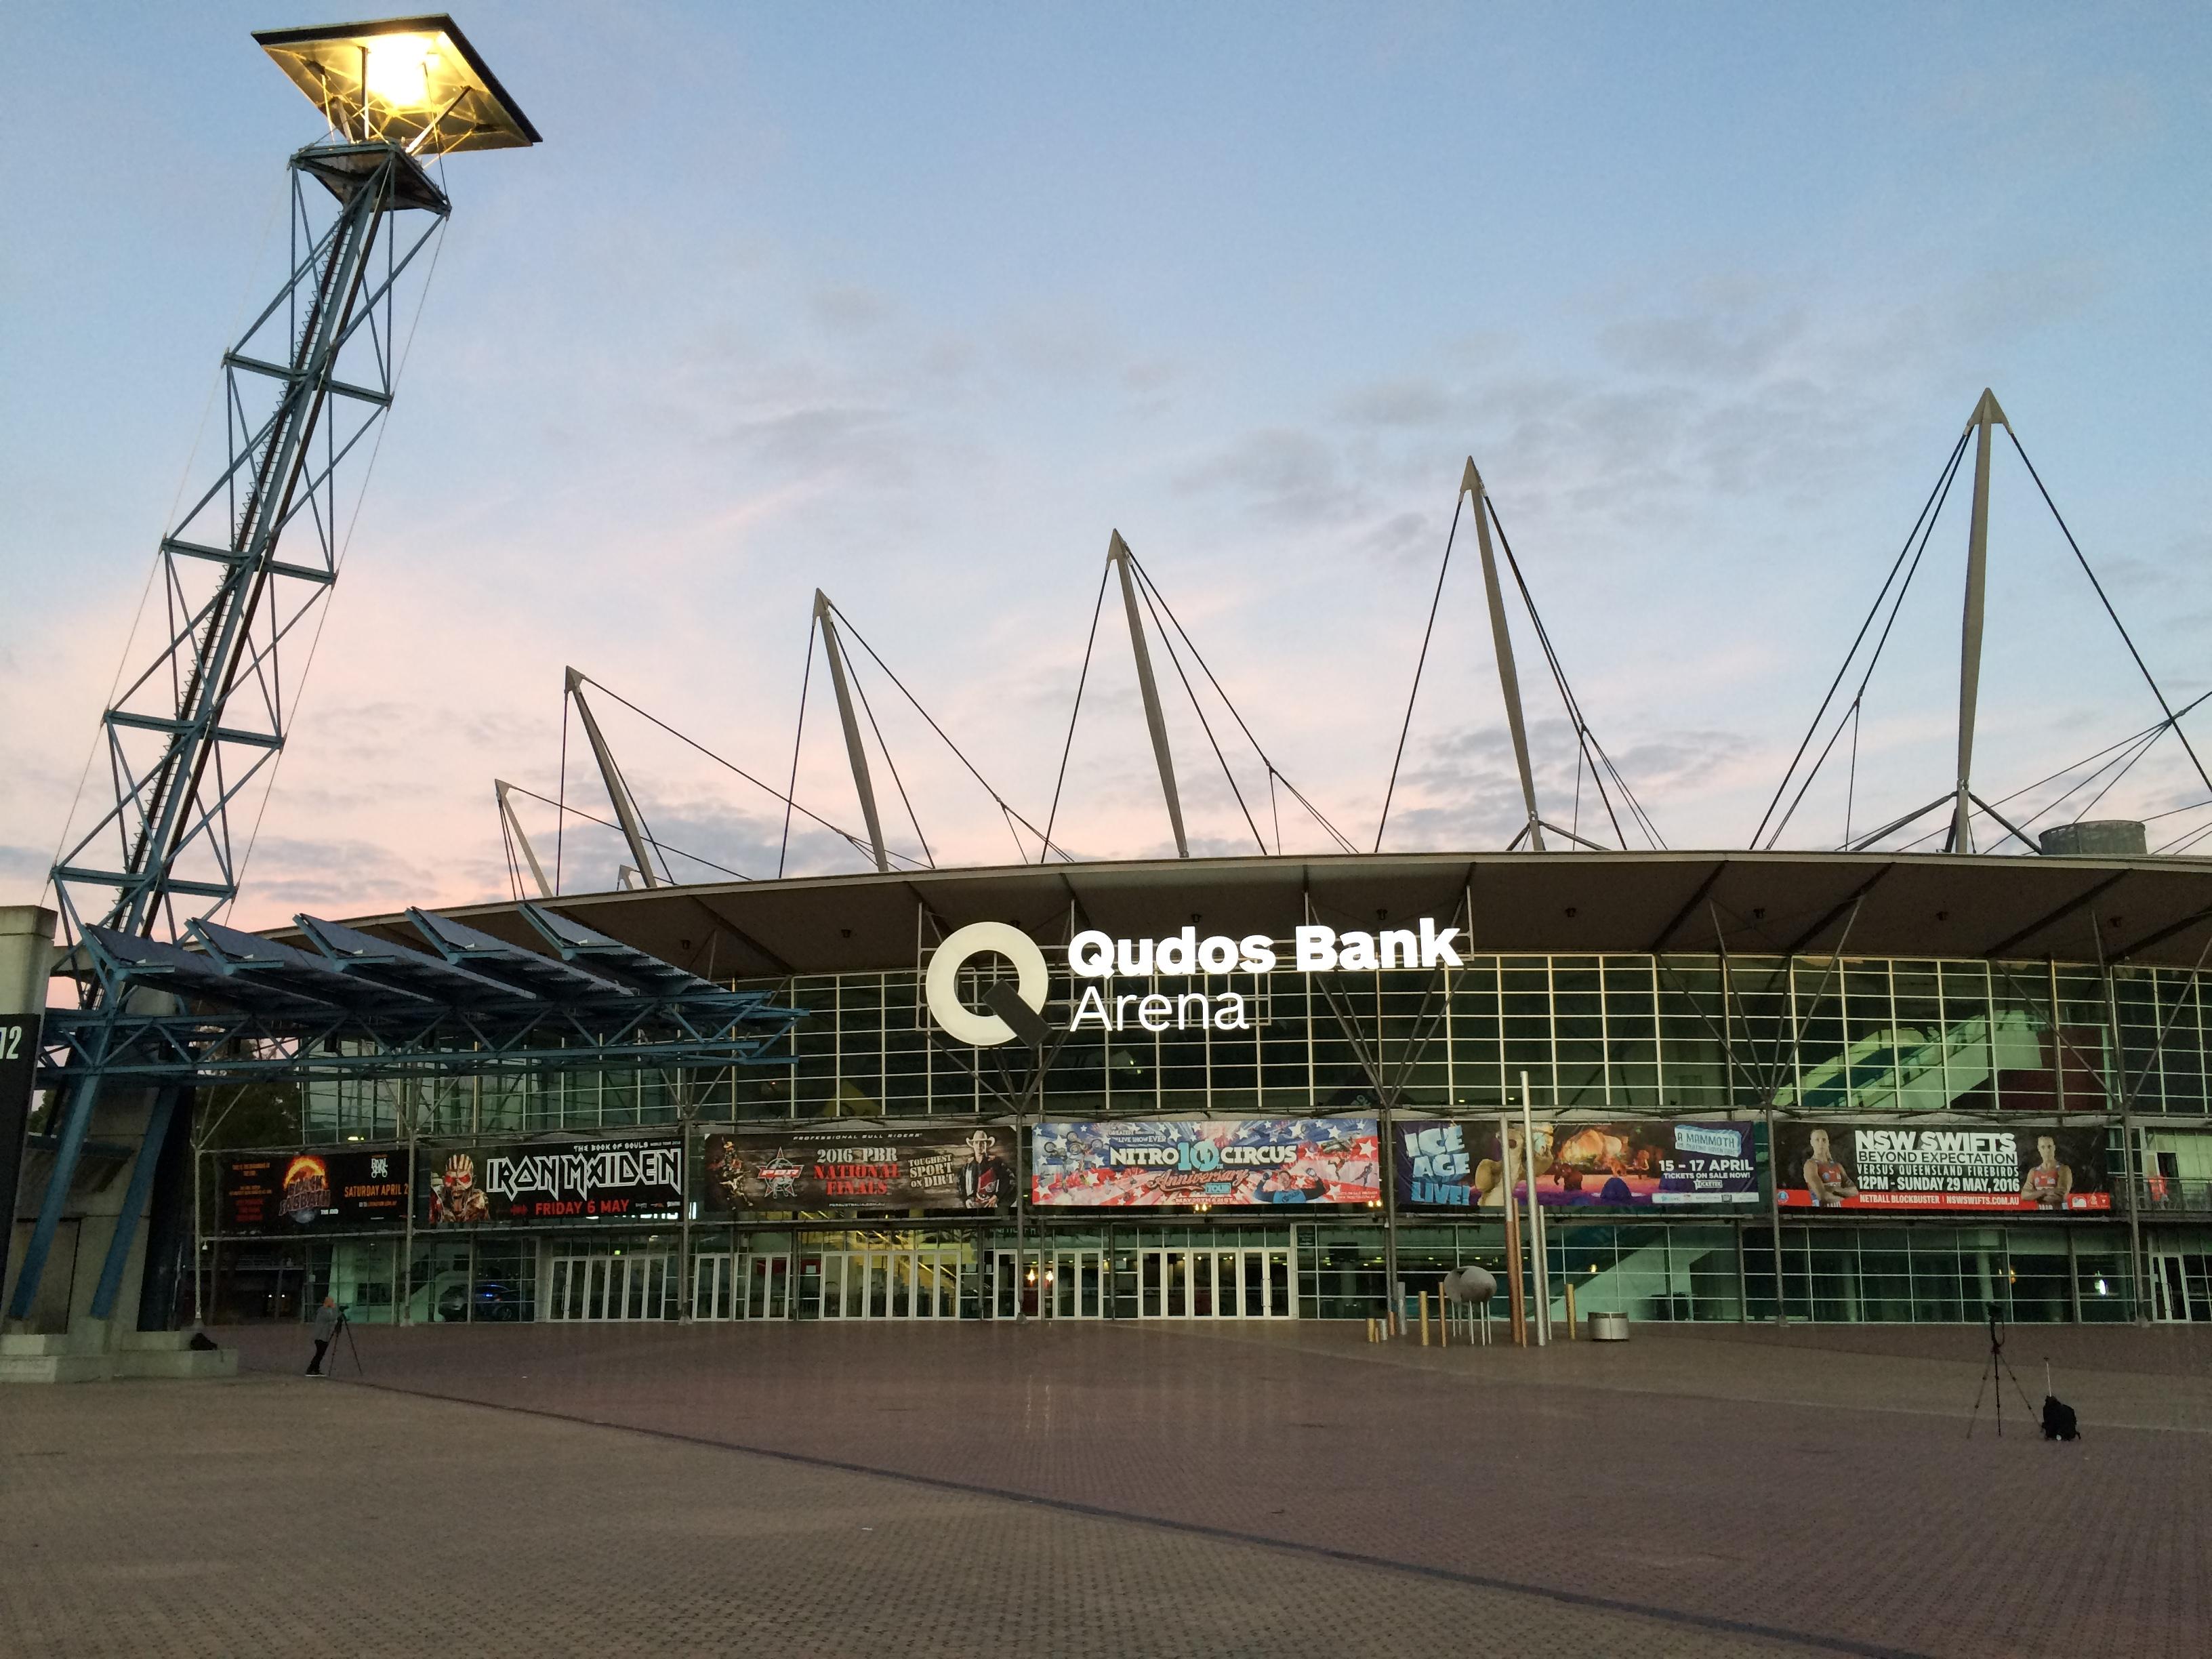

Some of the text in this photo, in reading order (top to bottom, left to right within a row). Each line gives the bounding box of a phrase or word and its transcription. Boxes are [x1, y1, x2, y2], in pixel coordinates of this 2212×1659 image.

[1067, 918, 1465, 978] Qudos Bank
[1069, 985, 1250, 1032] Arena
[573, 1145, 589, 1153] THE
[591, 1143, 611, 1151] BOOK
[624, 1141, 649, 1149] SOULS
[1404, 1124, 1465, 1158] ICE
[1677, 1132, 1735, 1148] A MAMMOTH
[1855, 1130, 2017, 1152] NSW SWIFTS
[817, 1147, 898, 1164] 2016 PBR
[908, 1154, 953, 1168] TOUGHEST
[1109, 1147, 1179, 1166] NITRO
[1221, 1145, 1298, 1165] CIRCUS
[1859, 1152, 2015, 1165] BEYOND EXPECTATION
[813, 1163, 900, 1180] NATIONAL
[909, 1162, 954, 1179] SPORT
[1412, 1152, 1471, 1178] AGE
[1658, 1160, 1674, 1172] 15
[1689, 1160, 1705, 1172] 17
[1709, 1159, 1754, 1172] APRIL
[1857, 1164, 2020, 1177] VERSUS QUEENSLAND FIREBIRDS
[487, 1148, 681, 1202] IRON MAIDEN
[911, 1173, 955, 1188] ON DIRT
[1149, 1168, 1250, 1189] Anniversary
[344, 1185, 380, 1198] SATURDAY
[381, 1184, 401, 1196] APRIL
[825, 1180, 888, 1196] FINALS
[1858, 1176, 1889, 1190] 12PM
[1897, 1176, 1945, 1191] SUNDAY
[1946, 1178, 1961, 1191] 29
[1963, 1178, 1991, 1193] MAY,
[1993, 1178, 2020, 1193] 2016
[1411, 1181, 1471, 1206] LIVE!
[1860, 1193, 2020, 1206] NETBALL BLOCKBUSTER NSWSWIFTS.COM.AU
[535, 1201, 583, 1215] FRIDAY
[587, 1200, 595, 1214] 6
[600, 1199, 630, 1213] MAY
